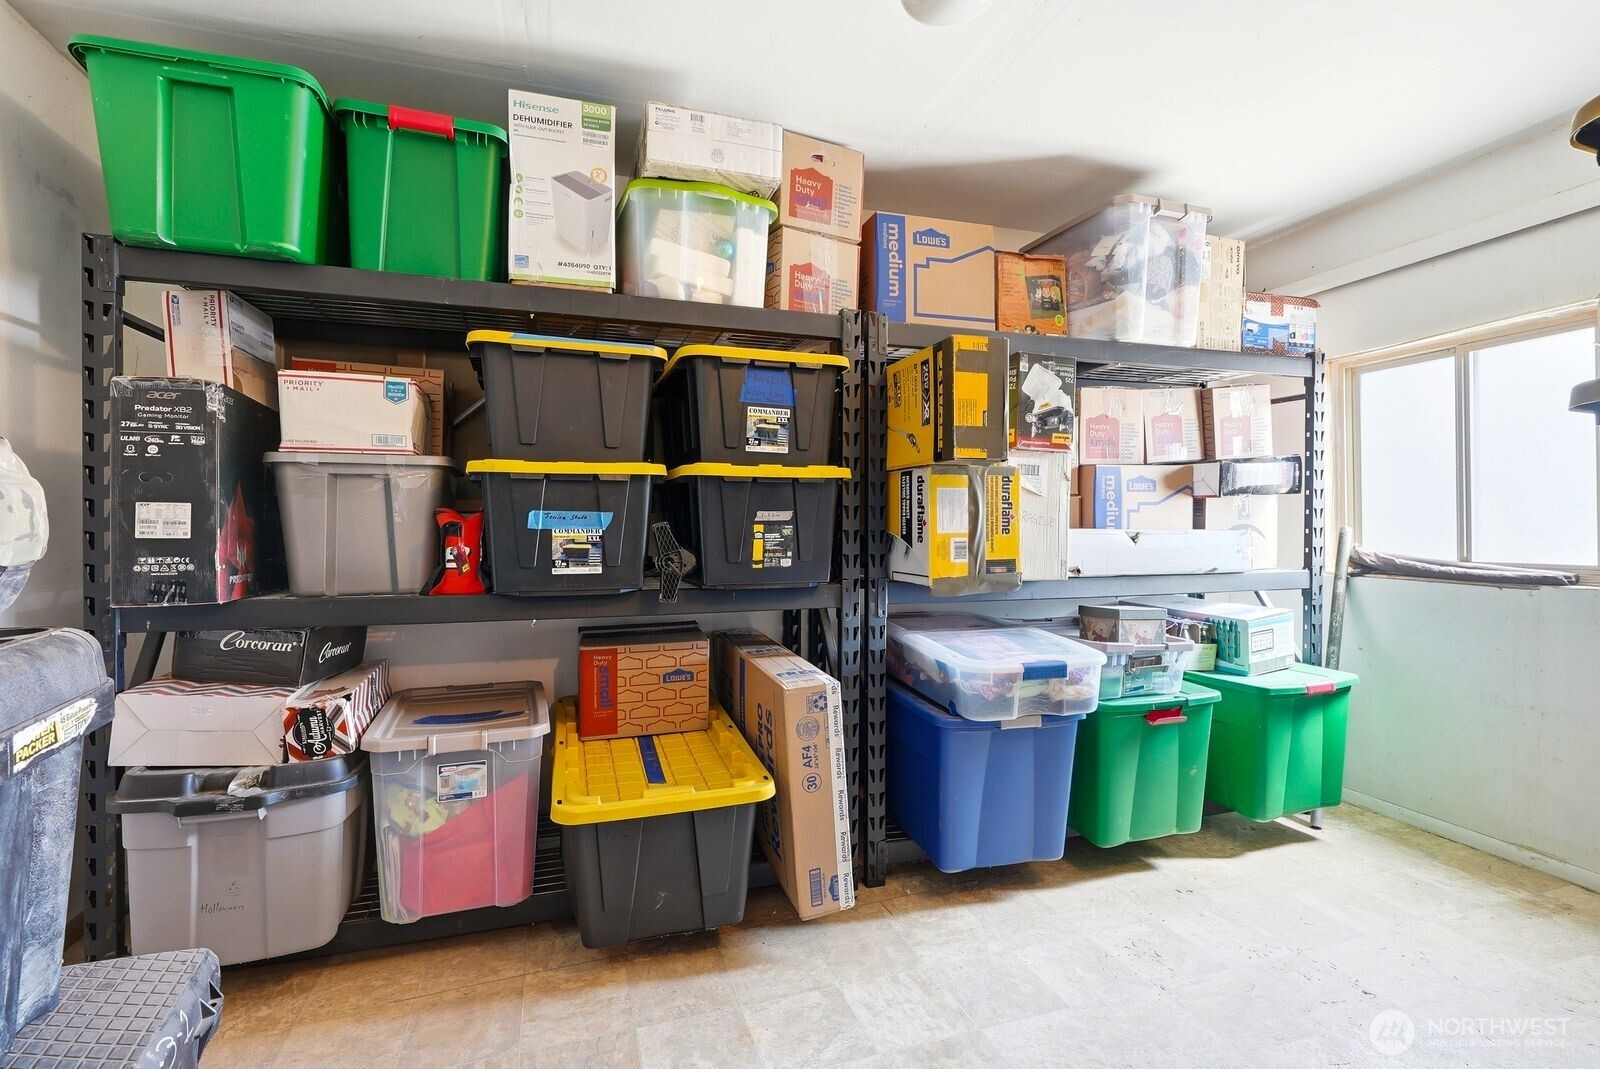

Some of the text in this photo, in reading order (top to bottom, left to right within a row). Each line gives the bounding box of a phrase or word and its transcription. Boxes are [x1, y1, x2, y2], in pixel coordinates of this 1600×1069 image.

[513, 99, 560, 114] Hisense
[583, 104, 607, 115] 3000
[513, 113, 573, 129] DEHUMIDIFIER
[795, 175, 822, 189] Heavy
[795, 184, 815, 197] Duty
[916, 233, 947, 247] LOWE'S
[888, 223, 903, 297] medium
[794, 270, 821, 283] Heavy
[794, 279, 813, 291] Duty
[208, 294, 217, 328] PRIORITY
[283, 379, 324, 387] PRIORITY
[146, 391, 182, 400] acer
[134, 404, 193, 414] Predator XB2
[137, 412, 163, 420] Gaming
[749, 407, 789, 416] COMMANDER
[1089, 423, 1111, 432] Heavy
[1089, 429, 1106, 438] Duty
[916, 475, 926, 544] duraflame
[1001, 475, 1011, 535] duraflame
[1105, 475, 1120, 529] mediu
[219, 630, 294, 652] Corcoran
[318, 641, 351, 664] Corcoran
[665, 673, 691, 682] LOWE'S
[316, 710, 325, 735] HARVEST
[832, 704, 841, 738] Rewards
[307, 715, 327, 754] Autumn
[15, 733, 57, 763] PACKER
[801, 745, 813, 769] AF4
[835, 747, 843, 779] Rewards
[806, 775, 818, 791] 30
[837, 789, 845, 822] Rewards
[840, 831, 848, 863] Rewards
[843, 872, 851, 905] Rewards
[200, 902, 244, 914] Halloween
